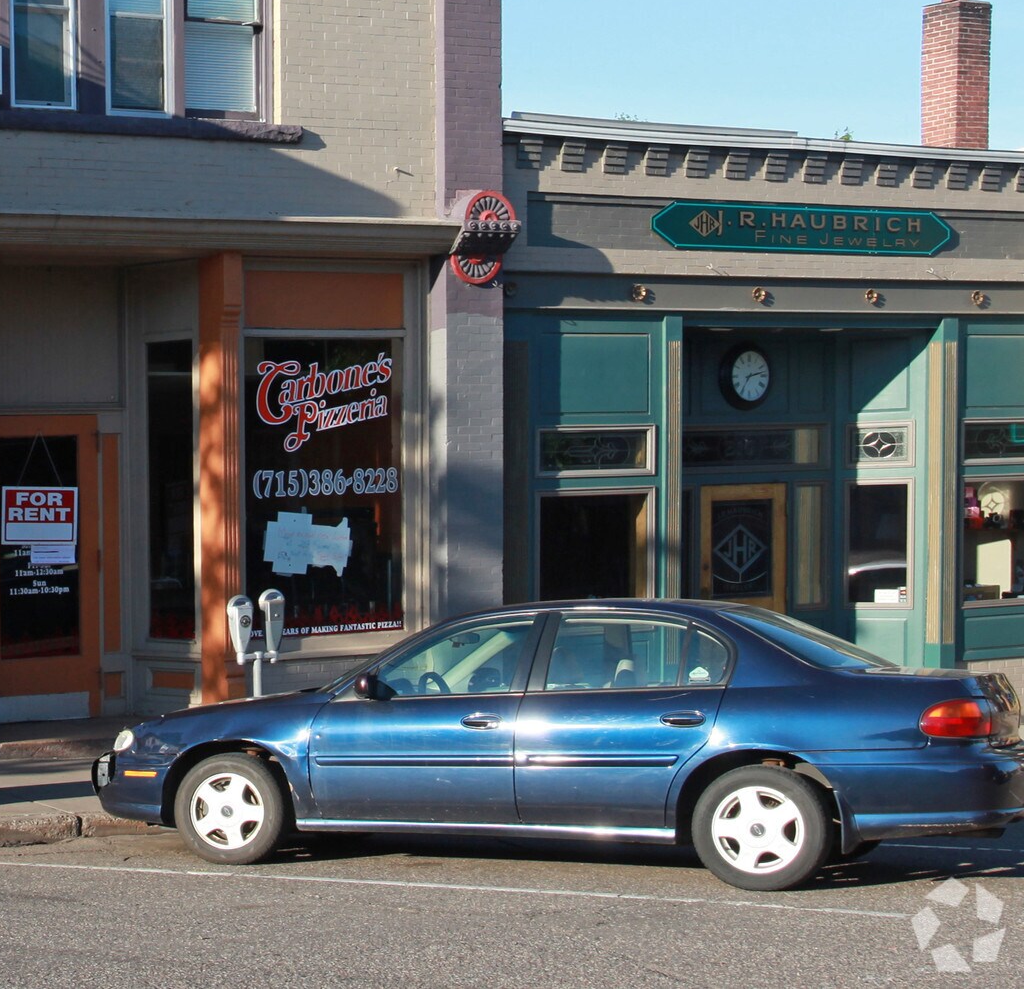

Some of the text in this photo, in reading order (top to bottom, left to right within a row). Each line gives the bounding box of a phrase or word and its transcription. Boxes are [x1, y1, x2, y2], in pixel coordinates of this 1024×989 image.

[771, 212, 922, 233] HAUBRICH
[255, 352, 393, 425] Carbone's
[283, 389, 389, 453] Pizzeria
[252, 467, 400, 499] (715)386-8228
[15, 492, 63, 507] FOR
[8, 507, 71, 522] RENT
[32, 579, 47, 587] Sun
[301, 626, 310, 634] OF
[311, 624, 338, 634] MAKING
[340, 622, 376, 631] FANTASTIC
[377, 621, 402, 629] PIZZA!!
